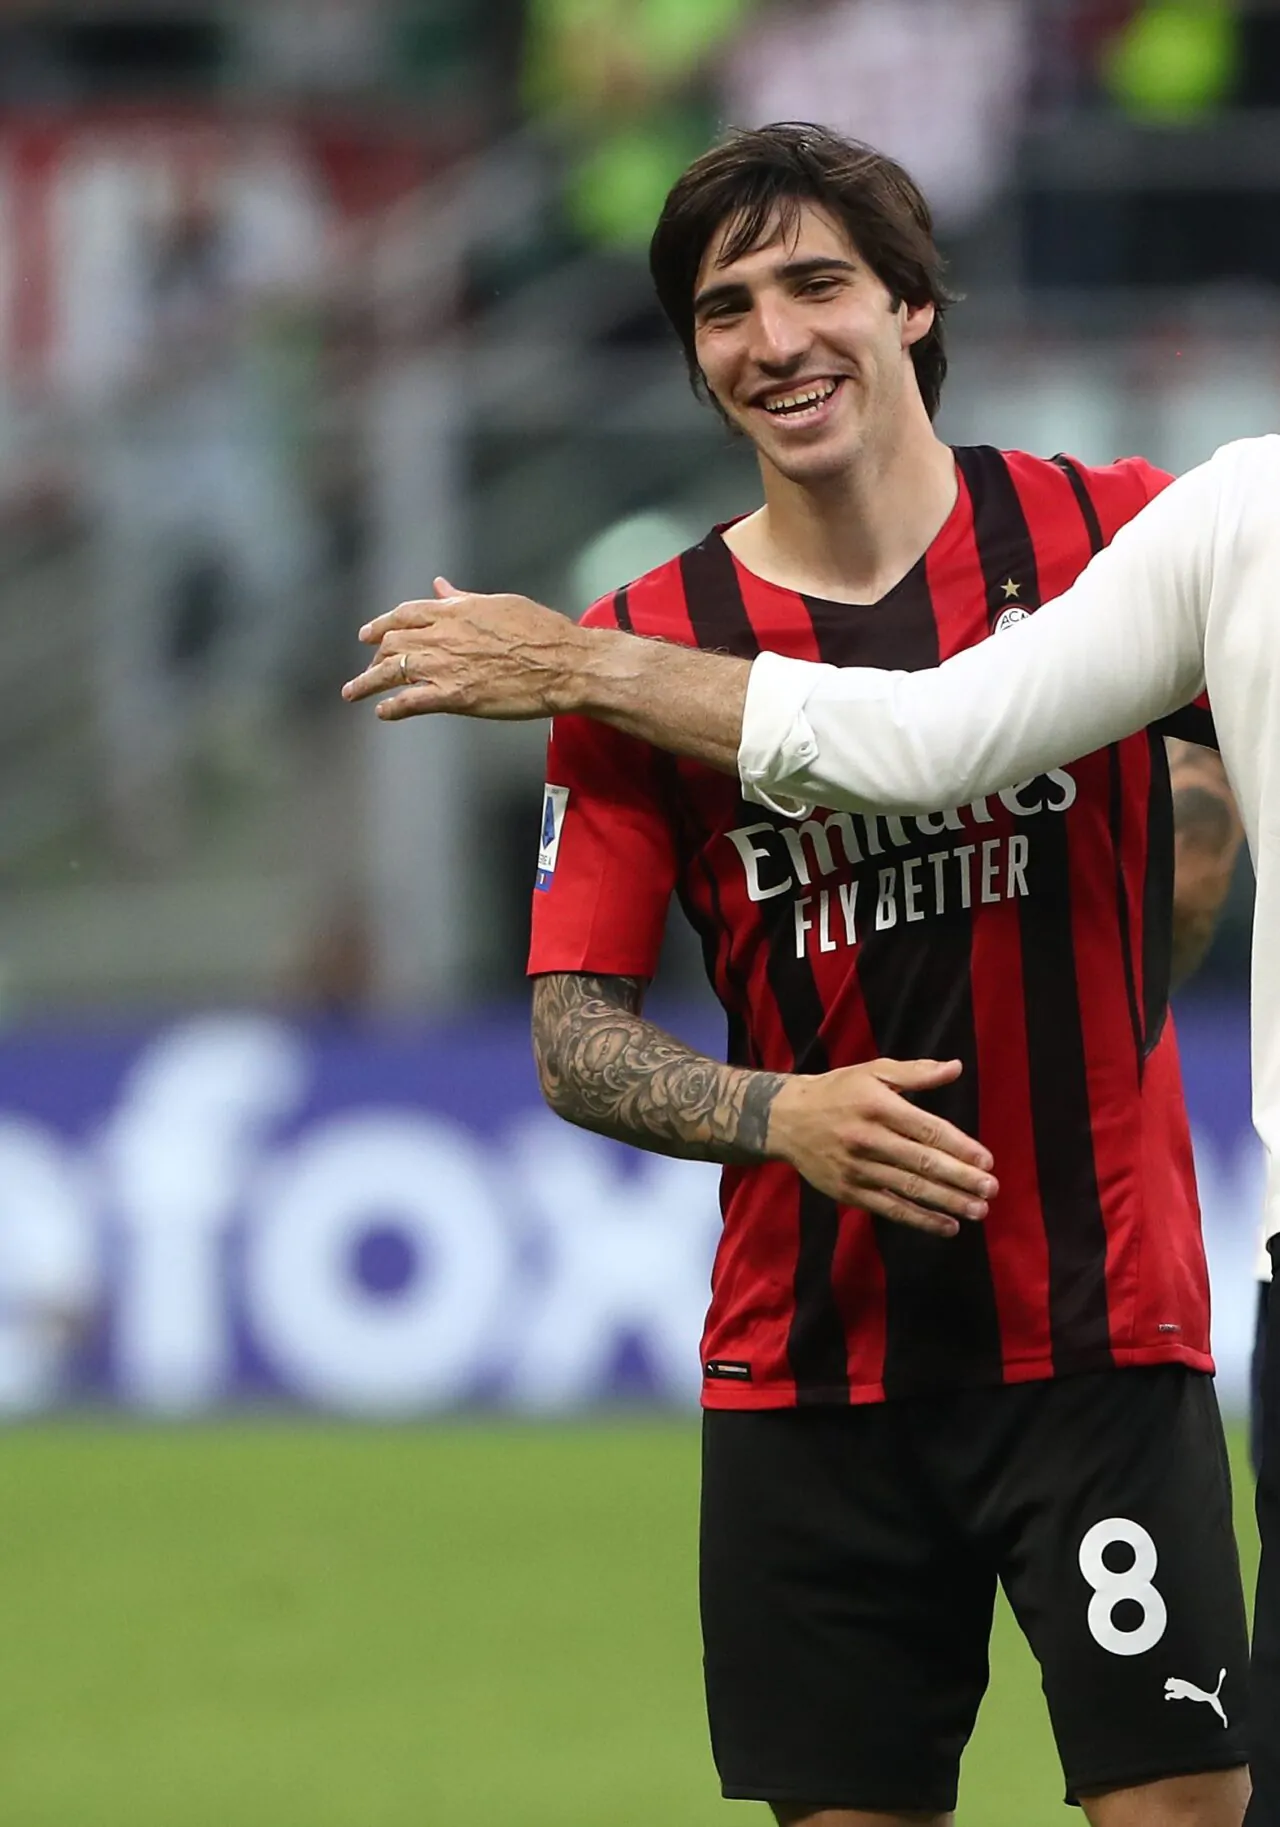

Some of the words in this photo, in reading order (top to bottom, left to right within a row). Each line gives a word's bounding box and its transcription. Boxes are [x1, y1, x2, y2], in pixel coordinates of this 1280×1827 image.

[795, 880, 859, 959] FLY
[875, 834, 1030, 931] BETTER
[1078, 1517, 1167, 1656] 8
